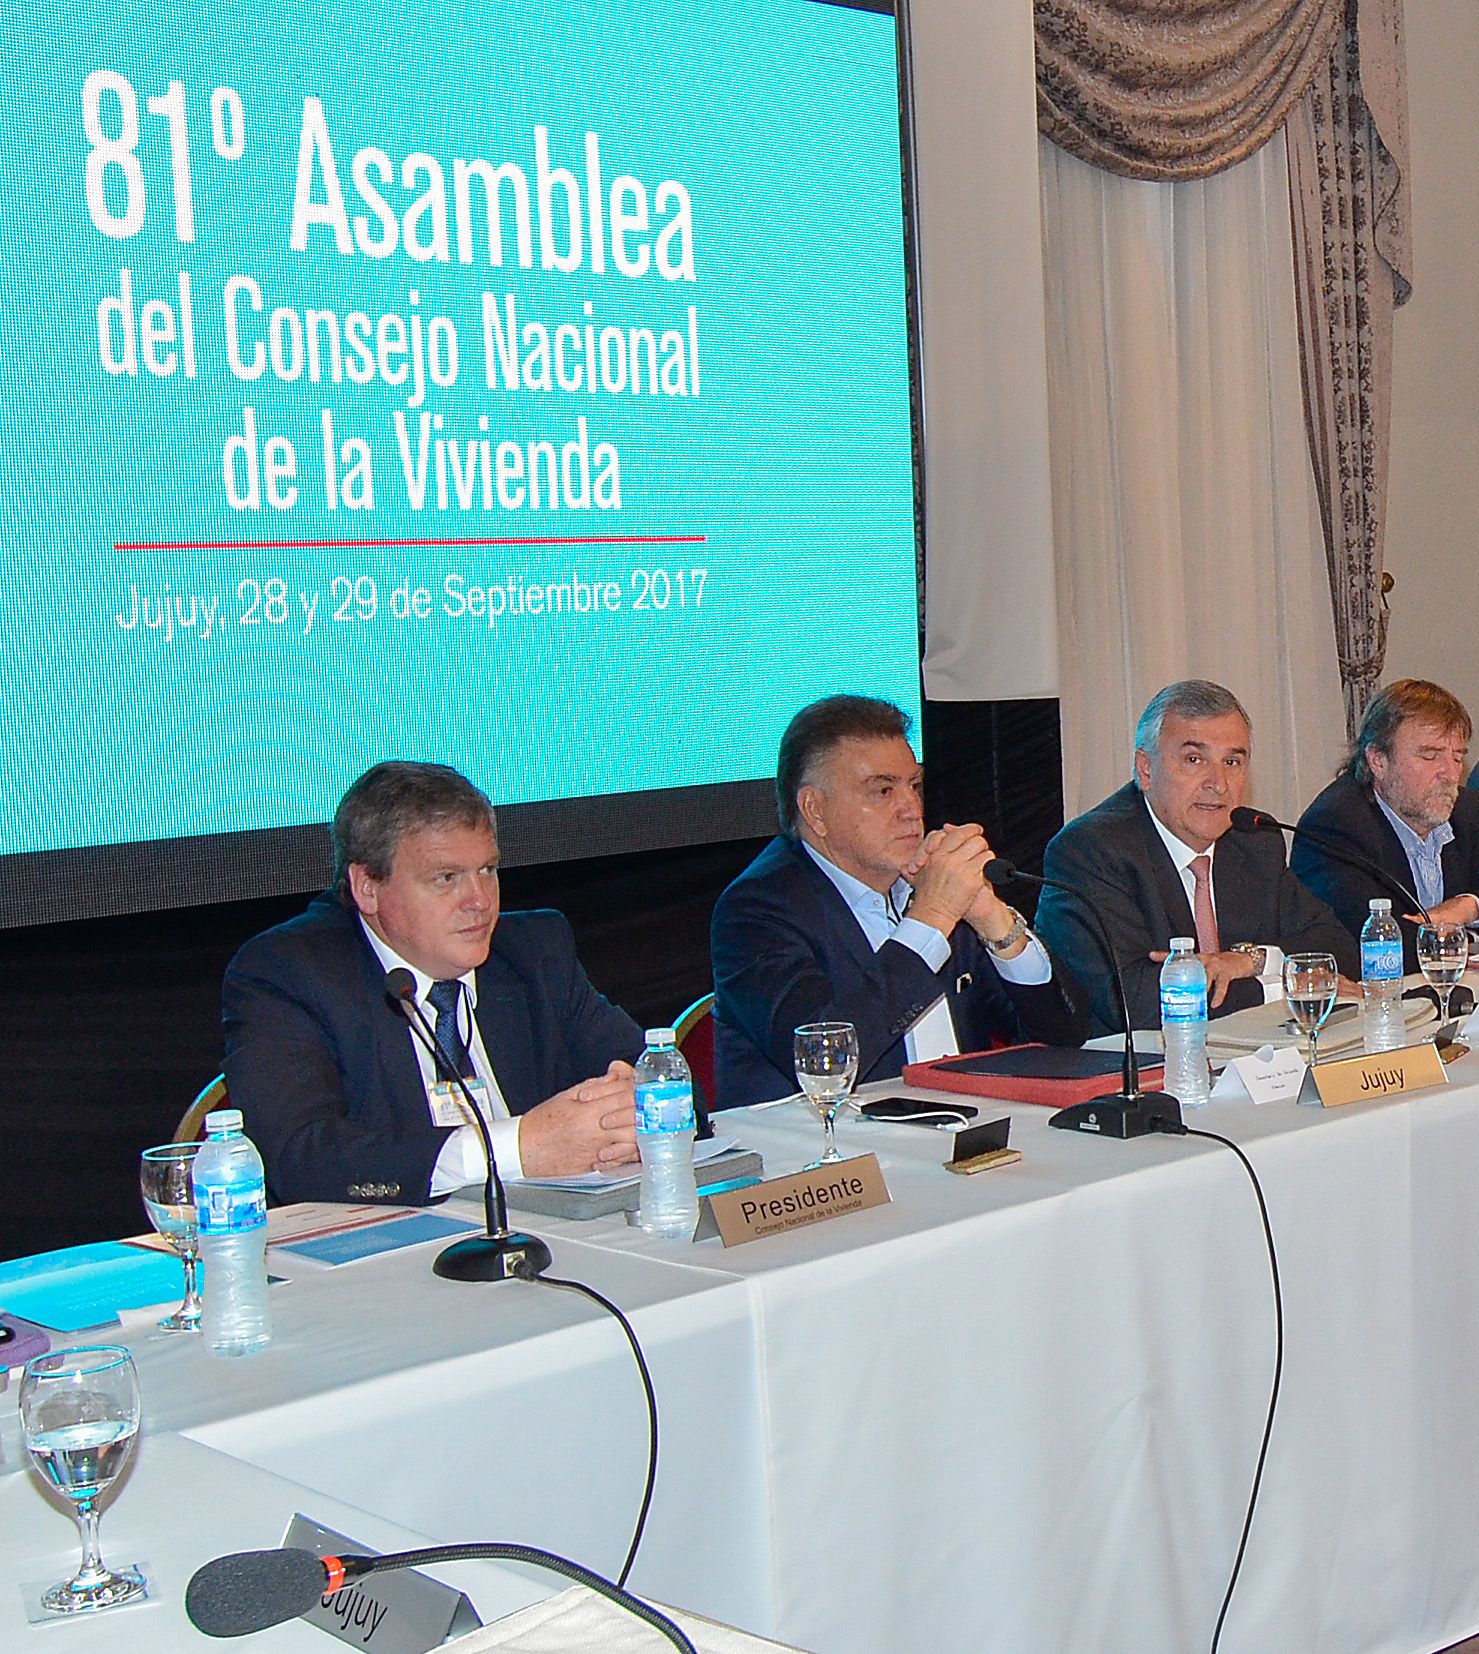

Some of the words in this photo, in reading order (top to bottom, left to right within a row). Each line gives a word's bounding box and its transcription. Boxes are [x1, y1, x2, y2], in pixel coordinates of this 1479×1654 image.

[289, 95, 697, 283] Asamblea
[95, 268, 197, 380] del
[222, 274, 459, 409] Consejo
[481, 291, 701, 397] Nacional
[222, 406, 298, 511] de
[322, 409, 373, 511] la
[393, 410, 623, 511] Vivienda
[115, 582, 226, 642] Jujuy,
[238, 578, 289, 625] 28
[300, 590, 319, 636] y
[332, 576, 378, 621] 29
[389, 575, 432, 619] de
[444, 569, 622, 629] Septiembre
[631, 568, 709, 610] 2017
[1360, 1067, 1406, 1093] Jujuy
[740, 1176, 864, 1225] Presidente
[754, 1220, 785, 1235] Consejo
[785, 1212, 816, 1226] Nacional
[815, 1208, 826, 1218] de
[833, 1199, 863, 1213] Vivienda
